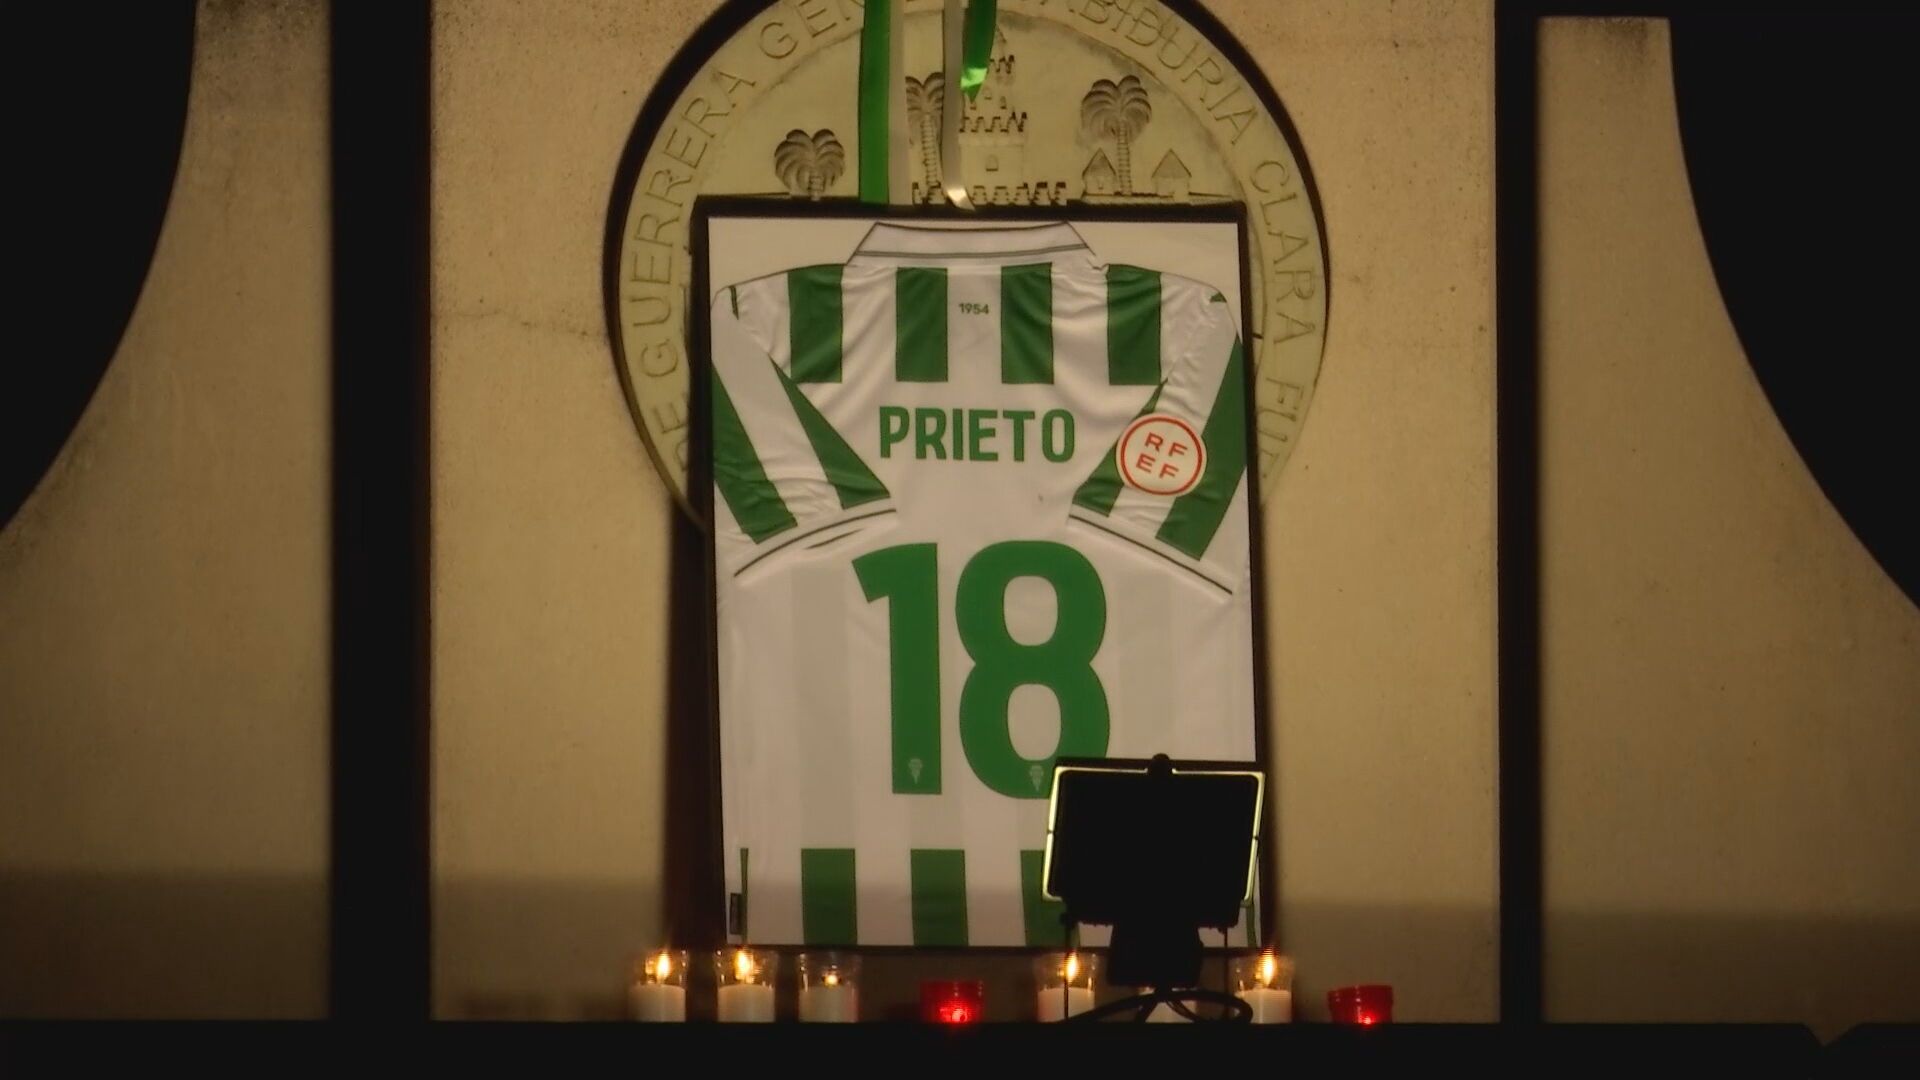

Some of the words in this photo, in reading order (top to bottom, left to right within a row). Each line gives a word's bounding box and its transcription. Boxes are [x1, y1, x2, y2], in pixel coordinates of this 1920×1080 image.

[629, 69, 757, 378] GUERRERA
[1040, 0, 1252, 145] BIDURIA
[1250, 159, 1316, 345] CLARA
[958, 302, 990, 316] 1954
[879, 406, 1075, 463] PRIETO
[851, 540, 1111, 800] 18
